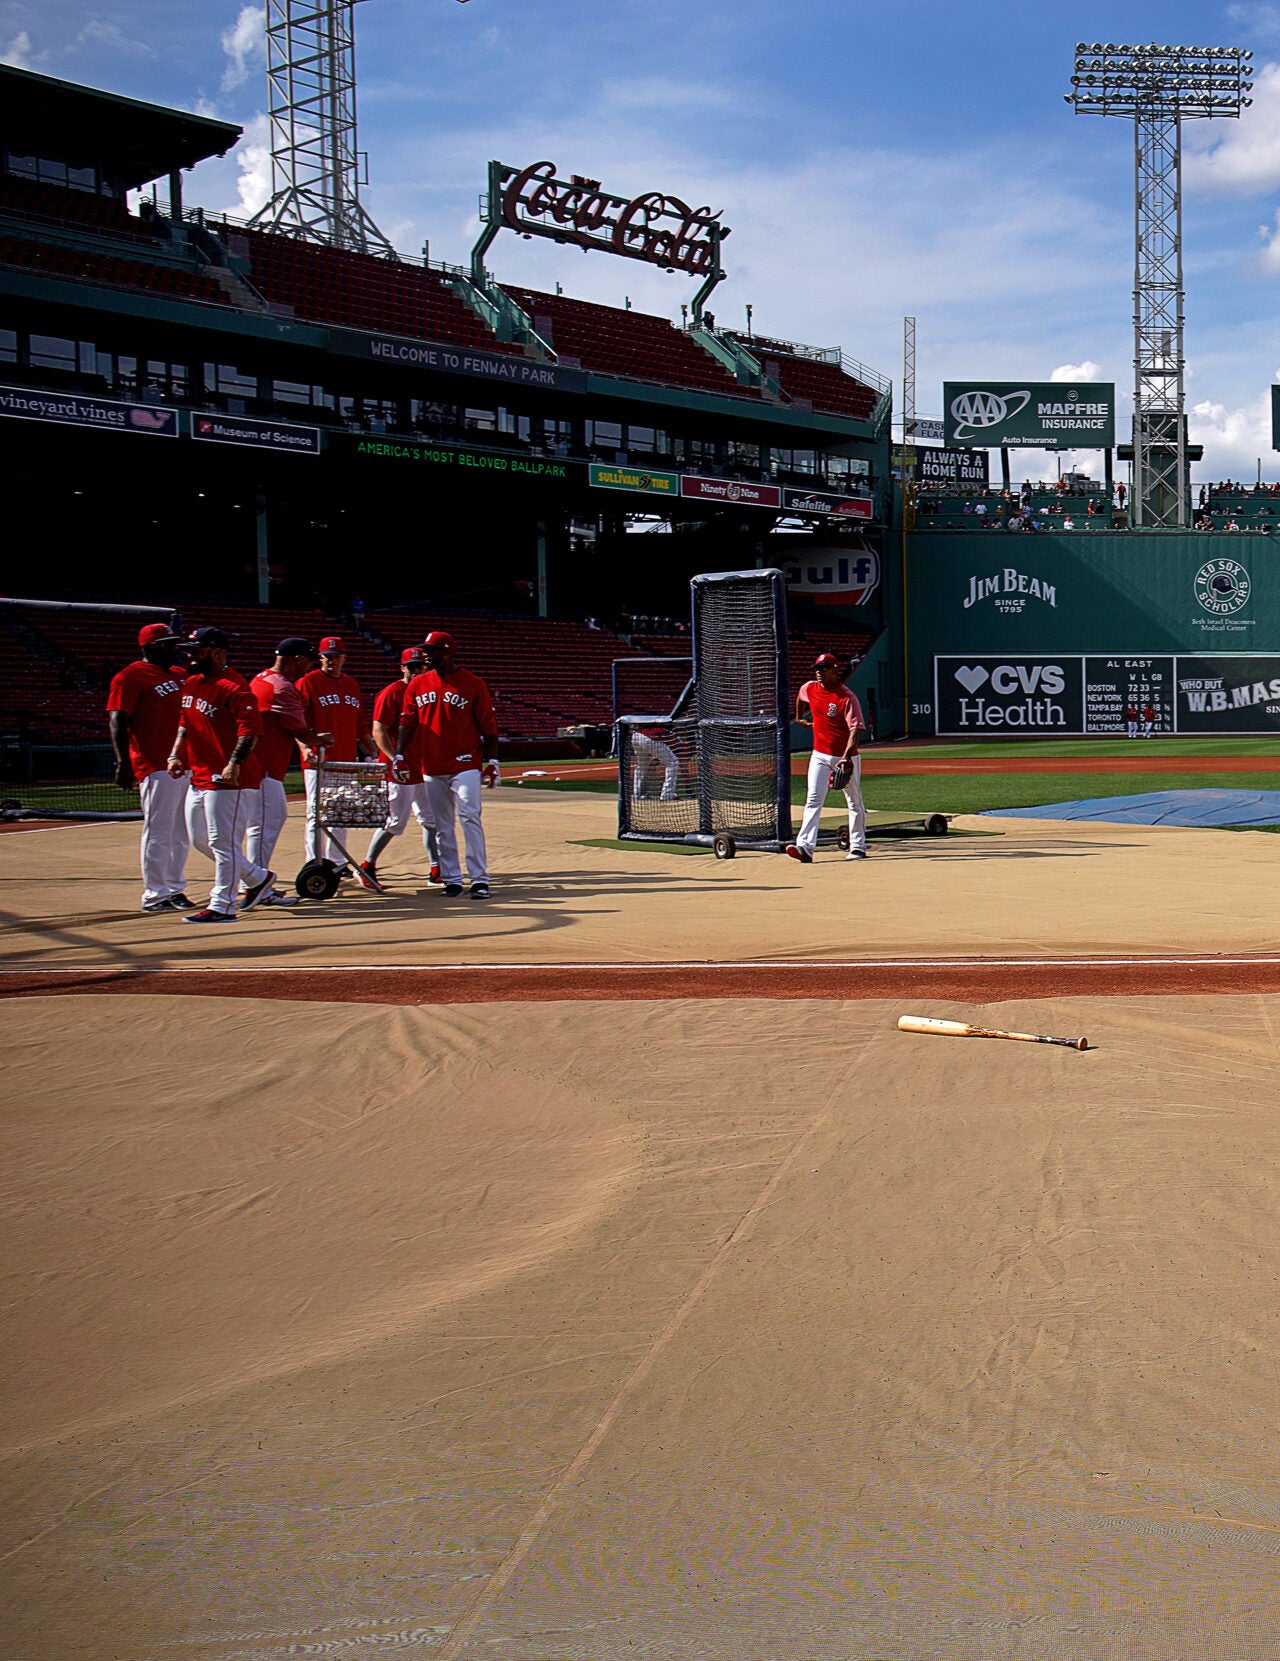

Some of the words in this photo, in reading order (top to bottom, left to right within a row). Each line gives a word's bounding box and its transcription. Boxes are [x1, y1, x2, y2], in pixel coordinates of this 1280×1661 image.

[503, 161, 724, 276] Coca-Cola
[370, 341, 438, 365] WELCOME
[442, 353, 459, 368] TO
[463, 357, 517, 378] FENWAY
[521, 367, 555, 384] PARK
[80, 404, 125, 422] vines
[958, 393, 1001, 427] AAA
[1037, 403, 1108, 415] MAPFRE
[1042, 418, 1107, 429] INSURANCE
[213, 424, 258, 439] Museum
[260, 431, 271, 441] of
[273, 432, 312, 446] Science
[1001, 436, 1021, 444] Auto
[1022, 436, 1058, 444] Insurance
[357, 442, 420, 459] AMERICA'S
[424, 450, 454, 463] MOST
[459, 454, 507, 470] BELOVED
[511, 460, 566, 477] BALLPARK
[924, 451, 970, 465] ALWAYS
[974, 455, 983, 466] A
[922, 463, 956, 477] HOME
[961, 466, 984, 479] RUN
[652, 478, 670, 490] TIRE
[700, 483, 726, 496] Ninety
[740, 487, 759, 499] Nine
[791, 498, 832, 512] Safelite
[1197, 563, 1216, 584] RED
[1218, 560, 1241, 576] SOX
[963, 575, 1000, 608] JIM
[1003, 568, 1057, 607] BEAM
[1199, 581, 1248, 612] SCHOLARS
[1106, 660, 1120, 668] AL
[1124, 660, 1153, 668] EAST
[991, 665, 1066, 695] CVS
[1129, 673, 1136, 681] W
[1141, 673, 1148, 681] L
[1151, 673, 1163, 681] GB
[1179, 679, 1203, 690] WHO
[1204, 679, 1223, 689] BUT
[154, 680, 179, 697] RED
[1087, 684, 1117, 692] BOSTON
[1128, 684, 1138, 692] 72
[1140, 684, 1150, 692] 33
[318, 693, 340, 707] RED
[415, 690, 437, 708] RED
[442, 691, 469, 710] SOX
[1087, 694, 1103, 702] NEW
[1103, 694, 1123, 702] YORK
[1128, 694, 1139, 702] 65
[1140, 694, 1150, 702] 36
[181, 695, 194, 708] ED
[195, 697, 218, 718] SOX
[912, 703, 931, 714] 310
[959, 698, 1066, 726] Health
[1087, 703, 1110, 712] TAMPA
[1110, 703, 1124, 712] BAY
[1087, 723, 1126, 731] BALTIMORE
